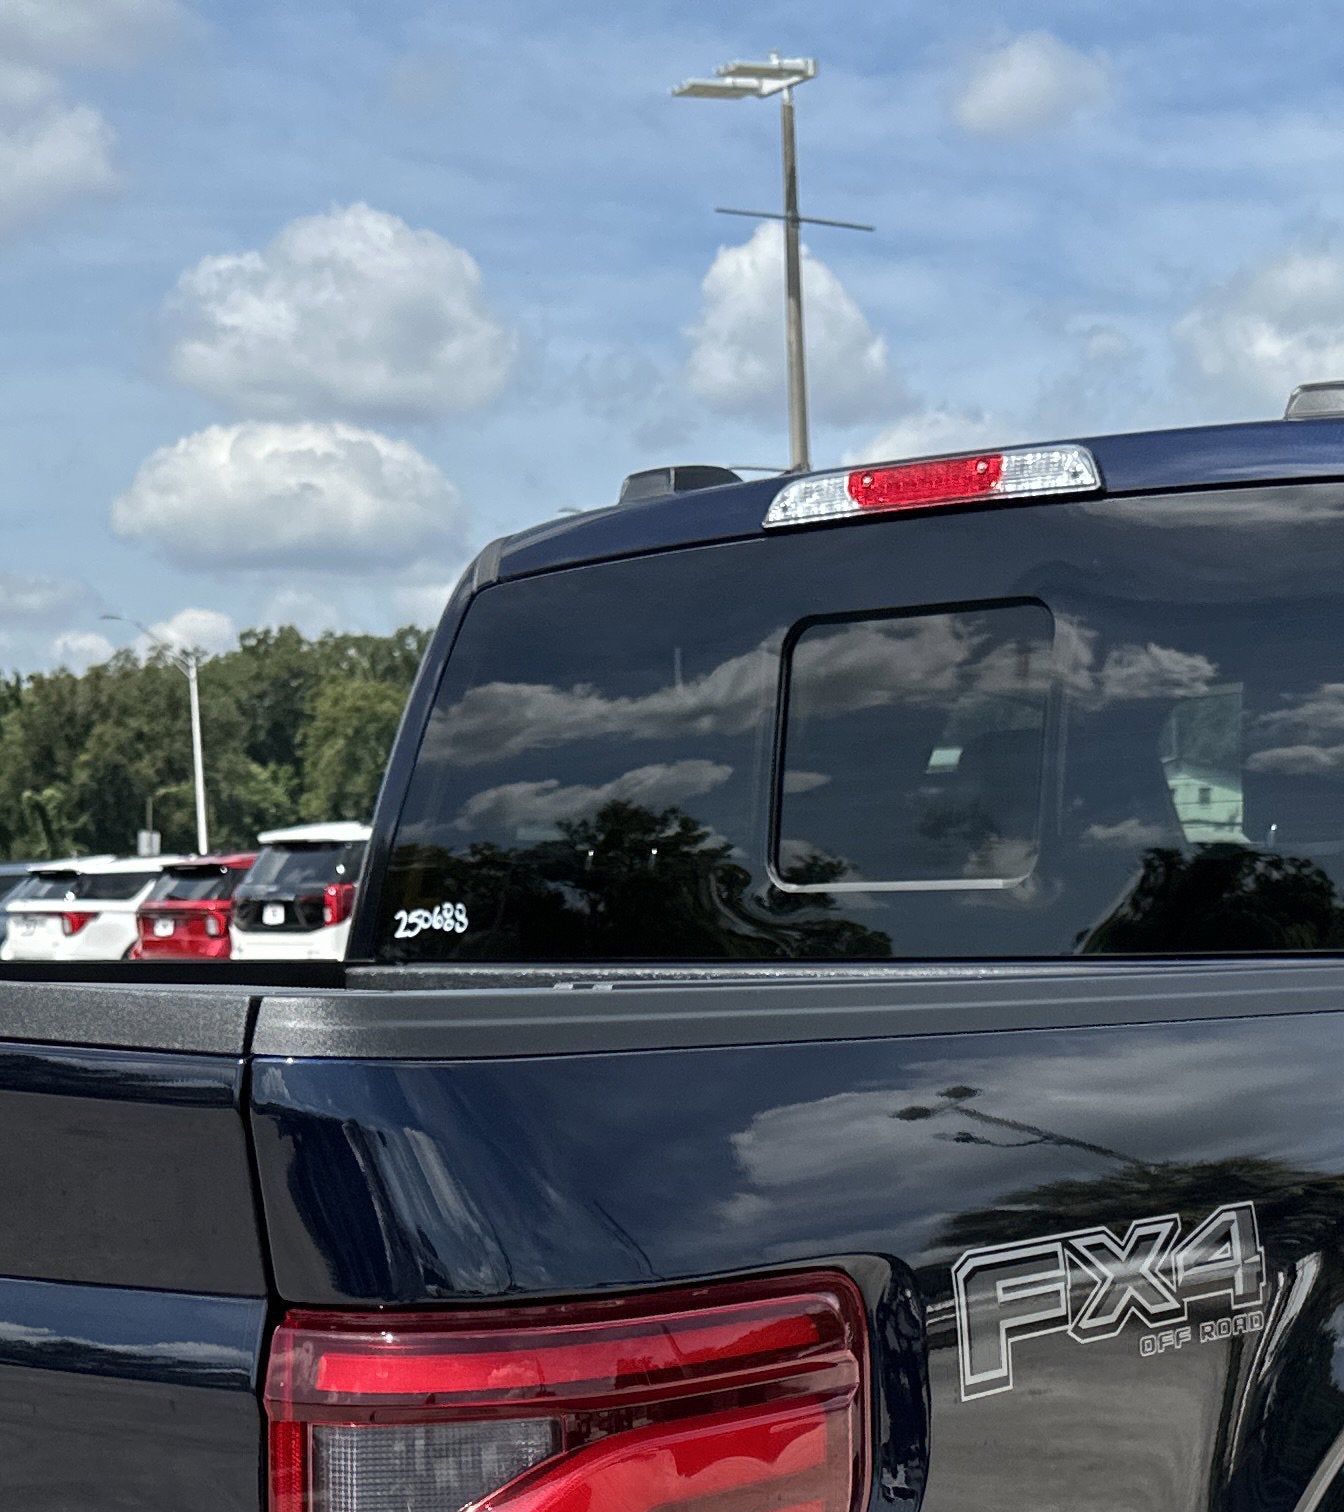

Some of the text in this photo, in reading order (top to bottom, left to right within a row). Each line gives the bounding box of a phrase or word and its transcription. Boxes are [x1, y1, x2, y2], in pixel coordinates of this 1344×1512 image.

[951, 1200, 1267, 1402] FX4
[1140, 1310, 1265, 1357] OFF ROAD
